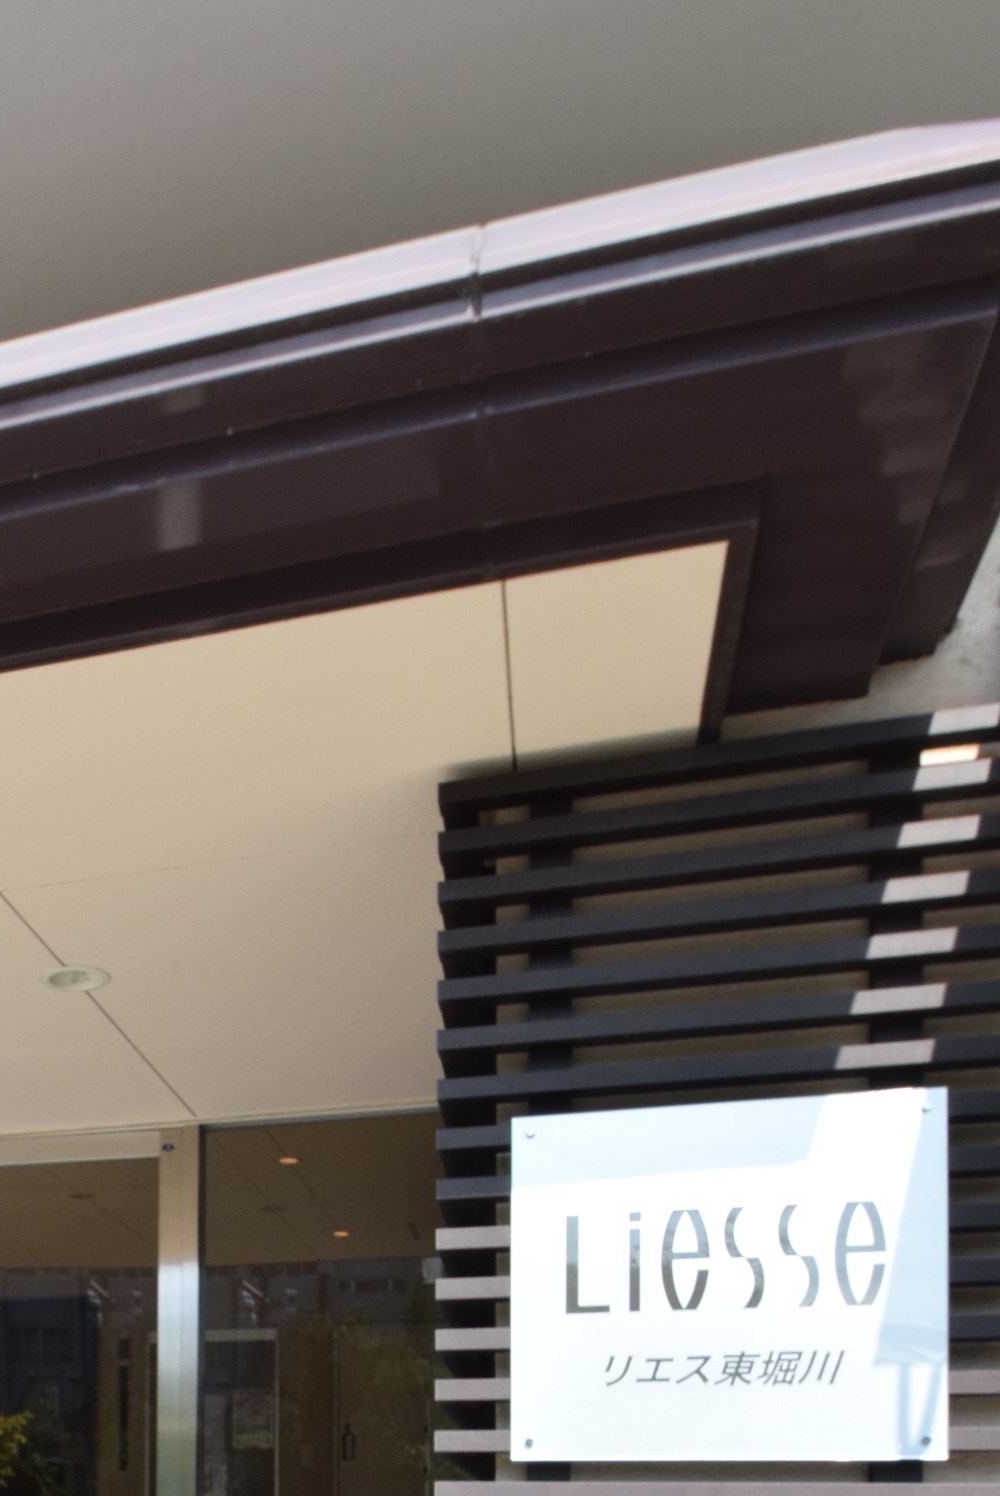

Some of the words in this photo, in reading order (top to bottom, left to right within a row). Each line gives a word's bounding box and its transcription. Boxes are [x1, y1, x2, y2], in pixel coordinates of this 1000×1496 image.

[565, 1201, 886, 1314] Liesse
[603, 1350, 845, 1386] リエス東堀川
